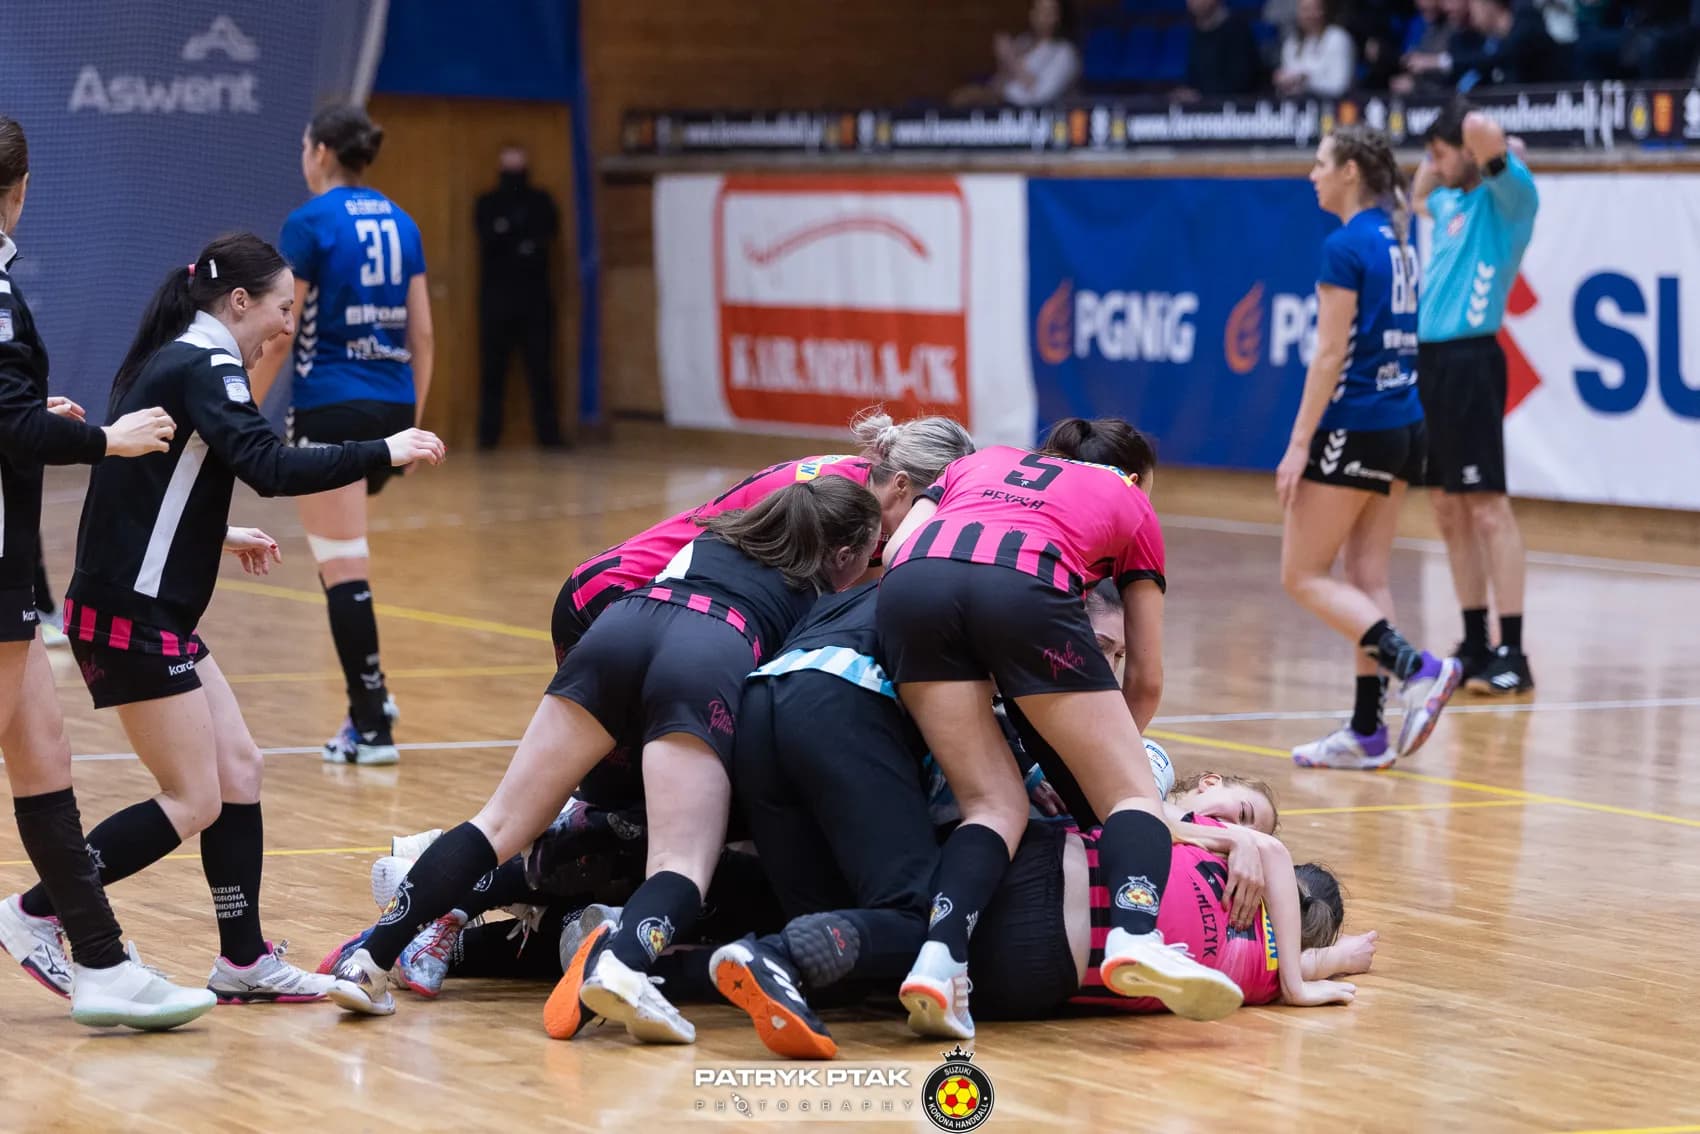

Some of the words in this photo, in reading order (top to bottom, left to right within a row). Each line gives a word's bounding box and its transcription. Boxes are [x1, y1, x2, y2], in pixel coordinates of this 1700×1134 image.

[68, 64, 260, 114] Aswent
[354, 218, 403, 287] 31
[1003, 453, 1064, 491] 5
